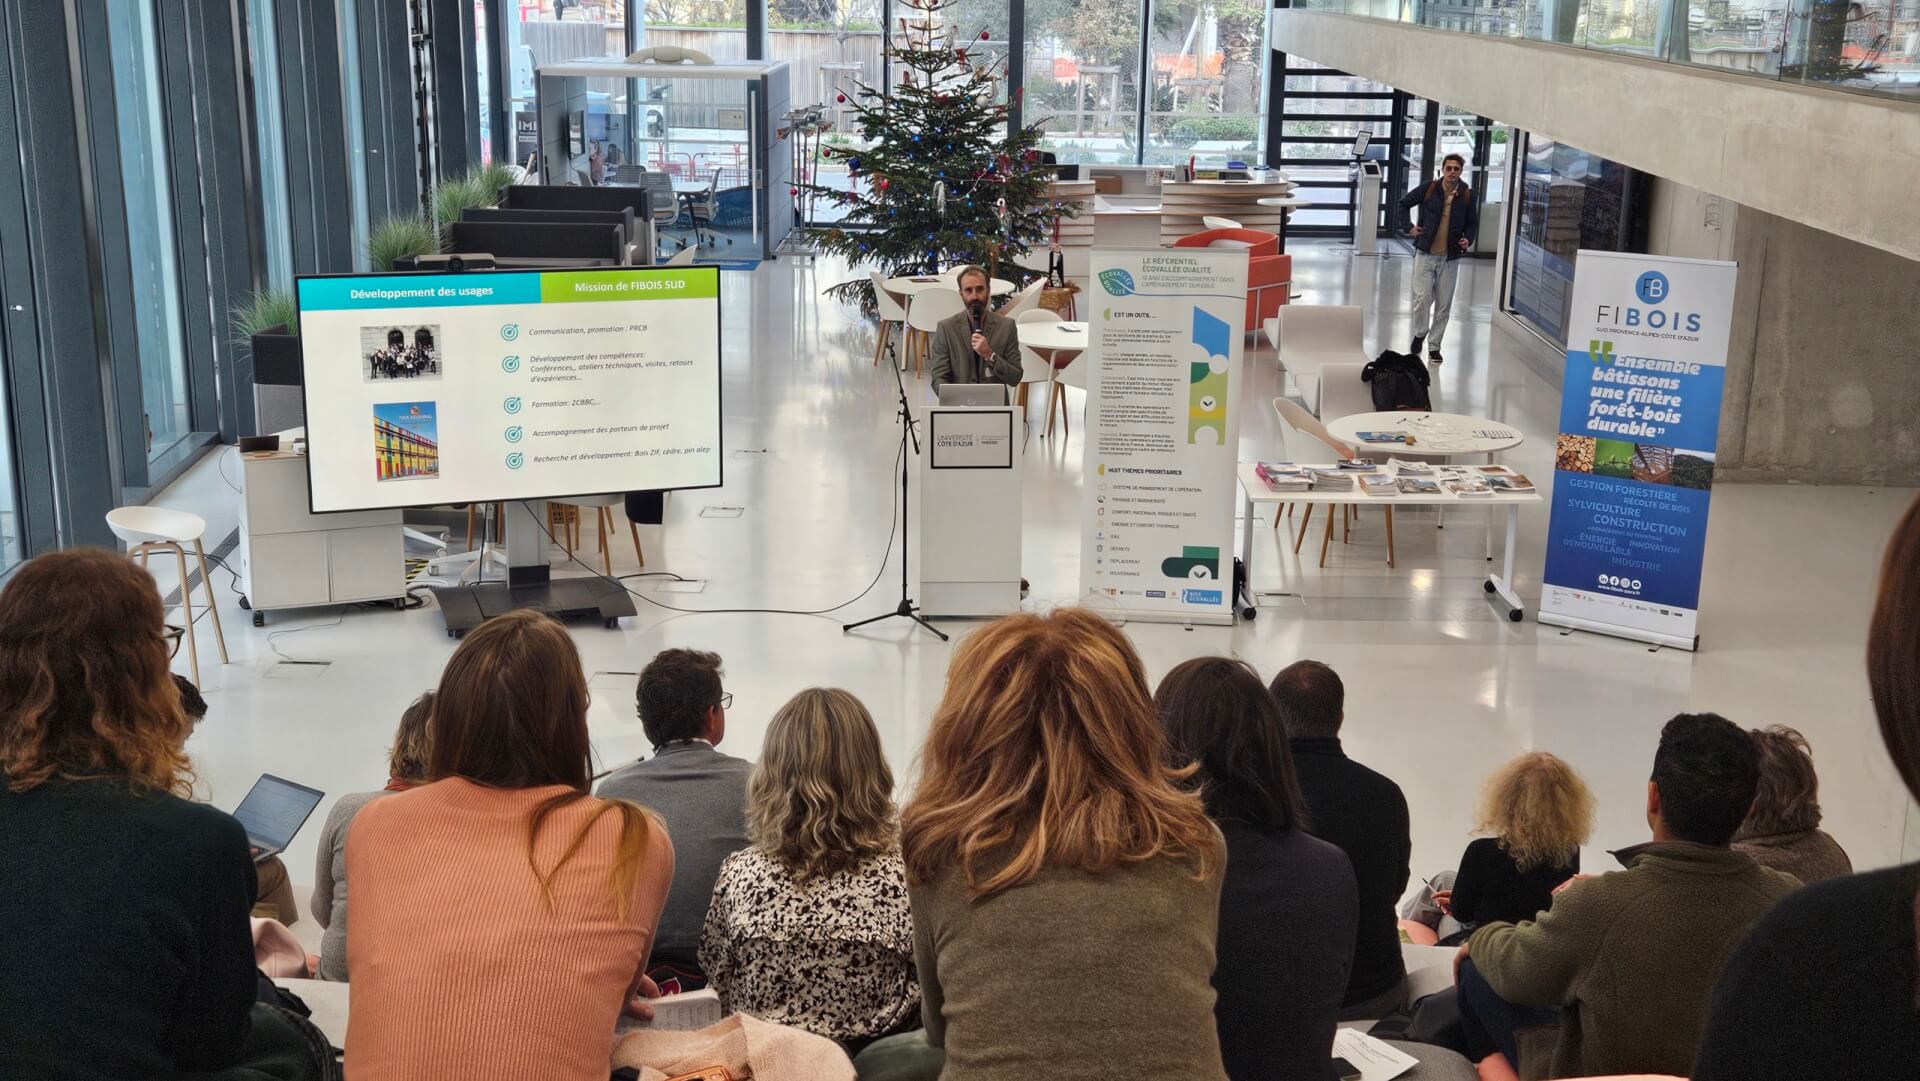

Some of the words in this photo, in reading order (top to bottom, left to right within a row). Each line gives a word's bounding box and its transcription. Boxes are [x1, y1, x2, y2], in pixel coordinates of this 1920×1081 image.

[350, 288, 435, 300] Développement
[438, 286, 456, 296] des
[459, 287, 494, 297] usages
[575, 282, 613, 292] Mission
[616, 282, 628, 291] de
[631, 281, 662, 290] FIBOIS
[665, 280, 685, 289] SUD
[1596, 305, 1701, 332] FIBOIS
[529, 327, 586, 335] Communication,
[588, 326, 624, 334] promotion
[530, 354, 584, 363] Développement
[605, 361, 643, 370] techniques,
[1592, 367, 1680, 390] bâtissons
[1590, 386, 1623, 399] une
[1626, 388, 1682, 407] filière
[1588, 400, 1682, 424] forêt-bois
[533, 428, 594, 437] Accompagnement
[610, 425, 637, 433] porteurs
[650, 423, 669, 431] projet
[1145, 468, 1182, 476] PRIORITAIRES
[1570, 478, 1614, 492] GESTION
[1615, 485, 1678, 502] FORESTIÈRE
[1568, 498, 1641, 517] SYLVICULTURE
[1624, 497, 1658, 508] RÉCOLTE
[1659, 502, 1670, 510] DE
[1672, 504, 1690, 513] BOIS
[1593, 514, 1687, 536] CONSTRUCTION
[1563, 538, 1632, 556] RENOUVELABLE
[1580, 532, 1616, 546] ÉNERGIE
[1629, 540, 1680, 553] INNOVATION
[1612, 556, 1662, 571] INDUSTRIE
